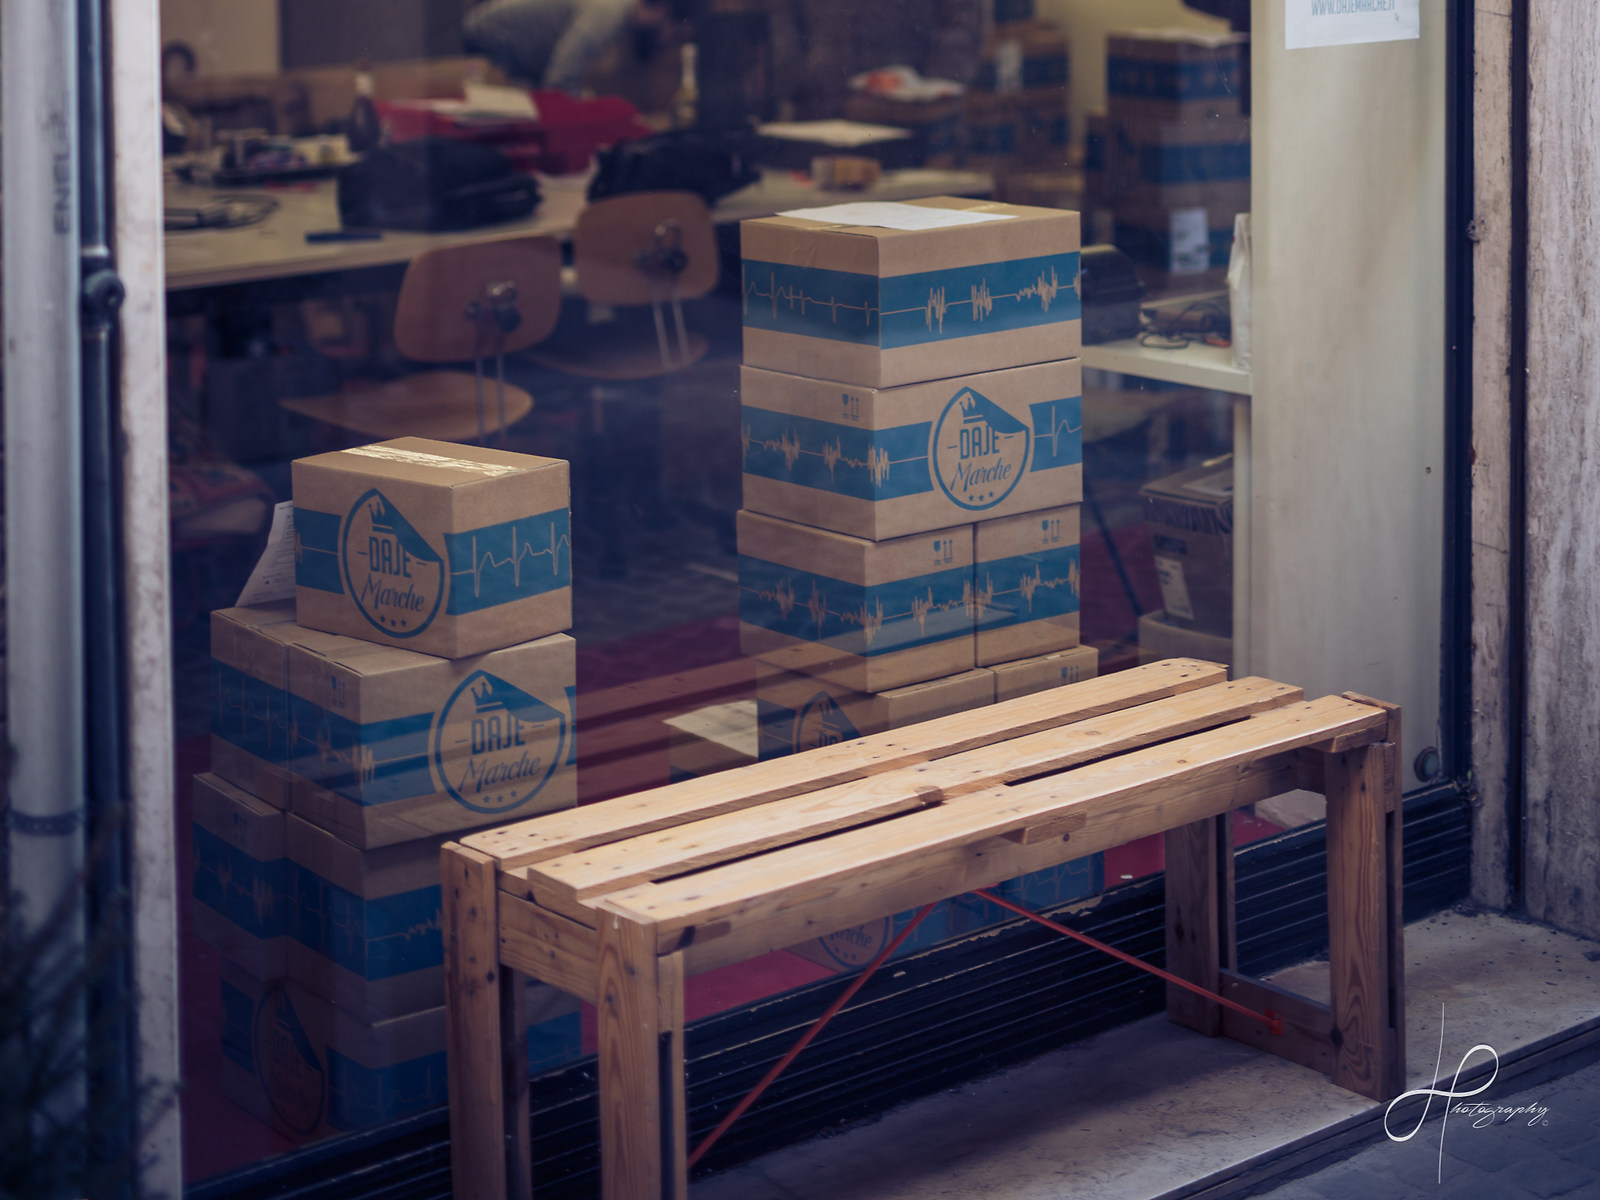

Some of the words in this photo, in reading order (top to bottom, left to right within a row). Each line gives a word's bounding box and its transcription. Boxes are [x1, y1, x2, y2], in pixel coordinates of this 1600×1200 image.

[960, 425, 1000, 460] DAJE
[950, 457, 1012, 492] Marche
[368, 536, 412, 578] DAJE
[360, 573, 425, 612] Marche
[471, 713, 526, 755] DAJE
[458, 750, 541, 793] Marche
